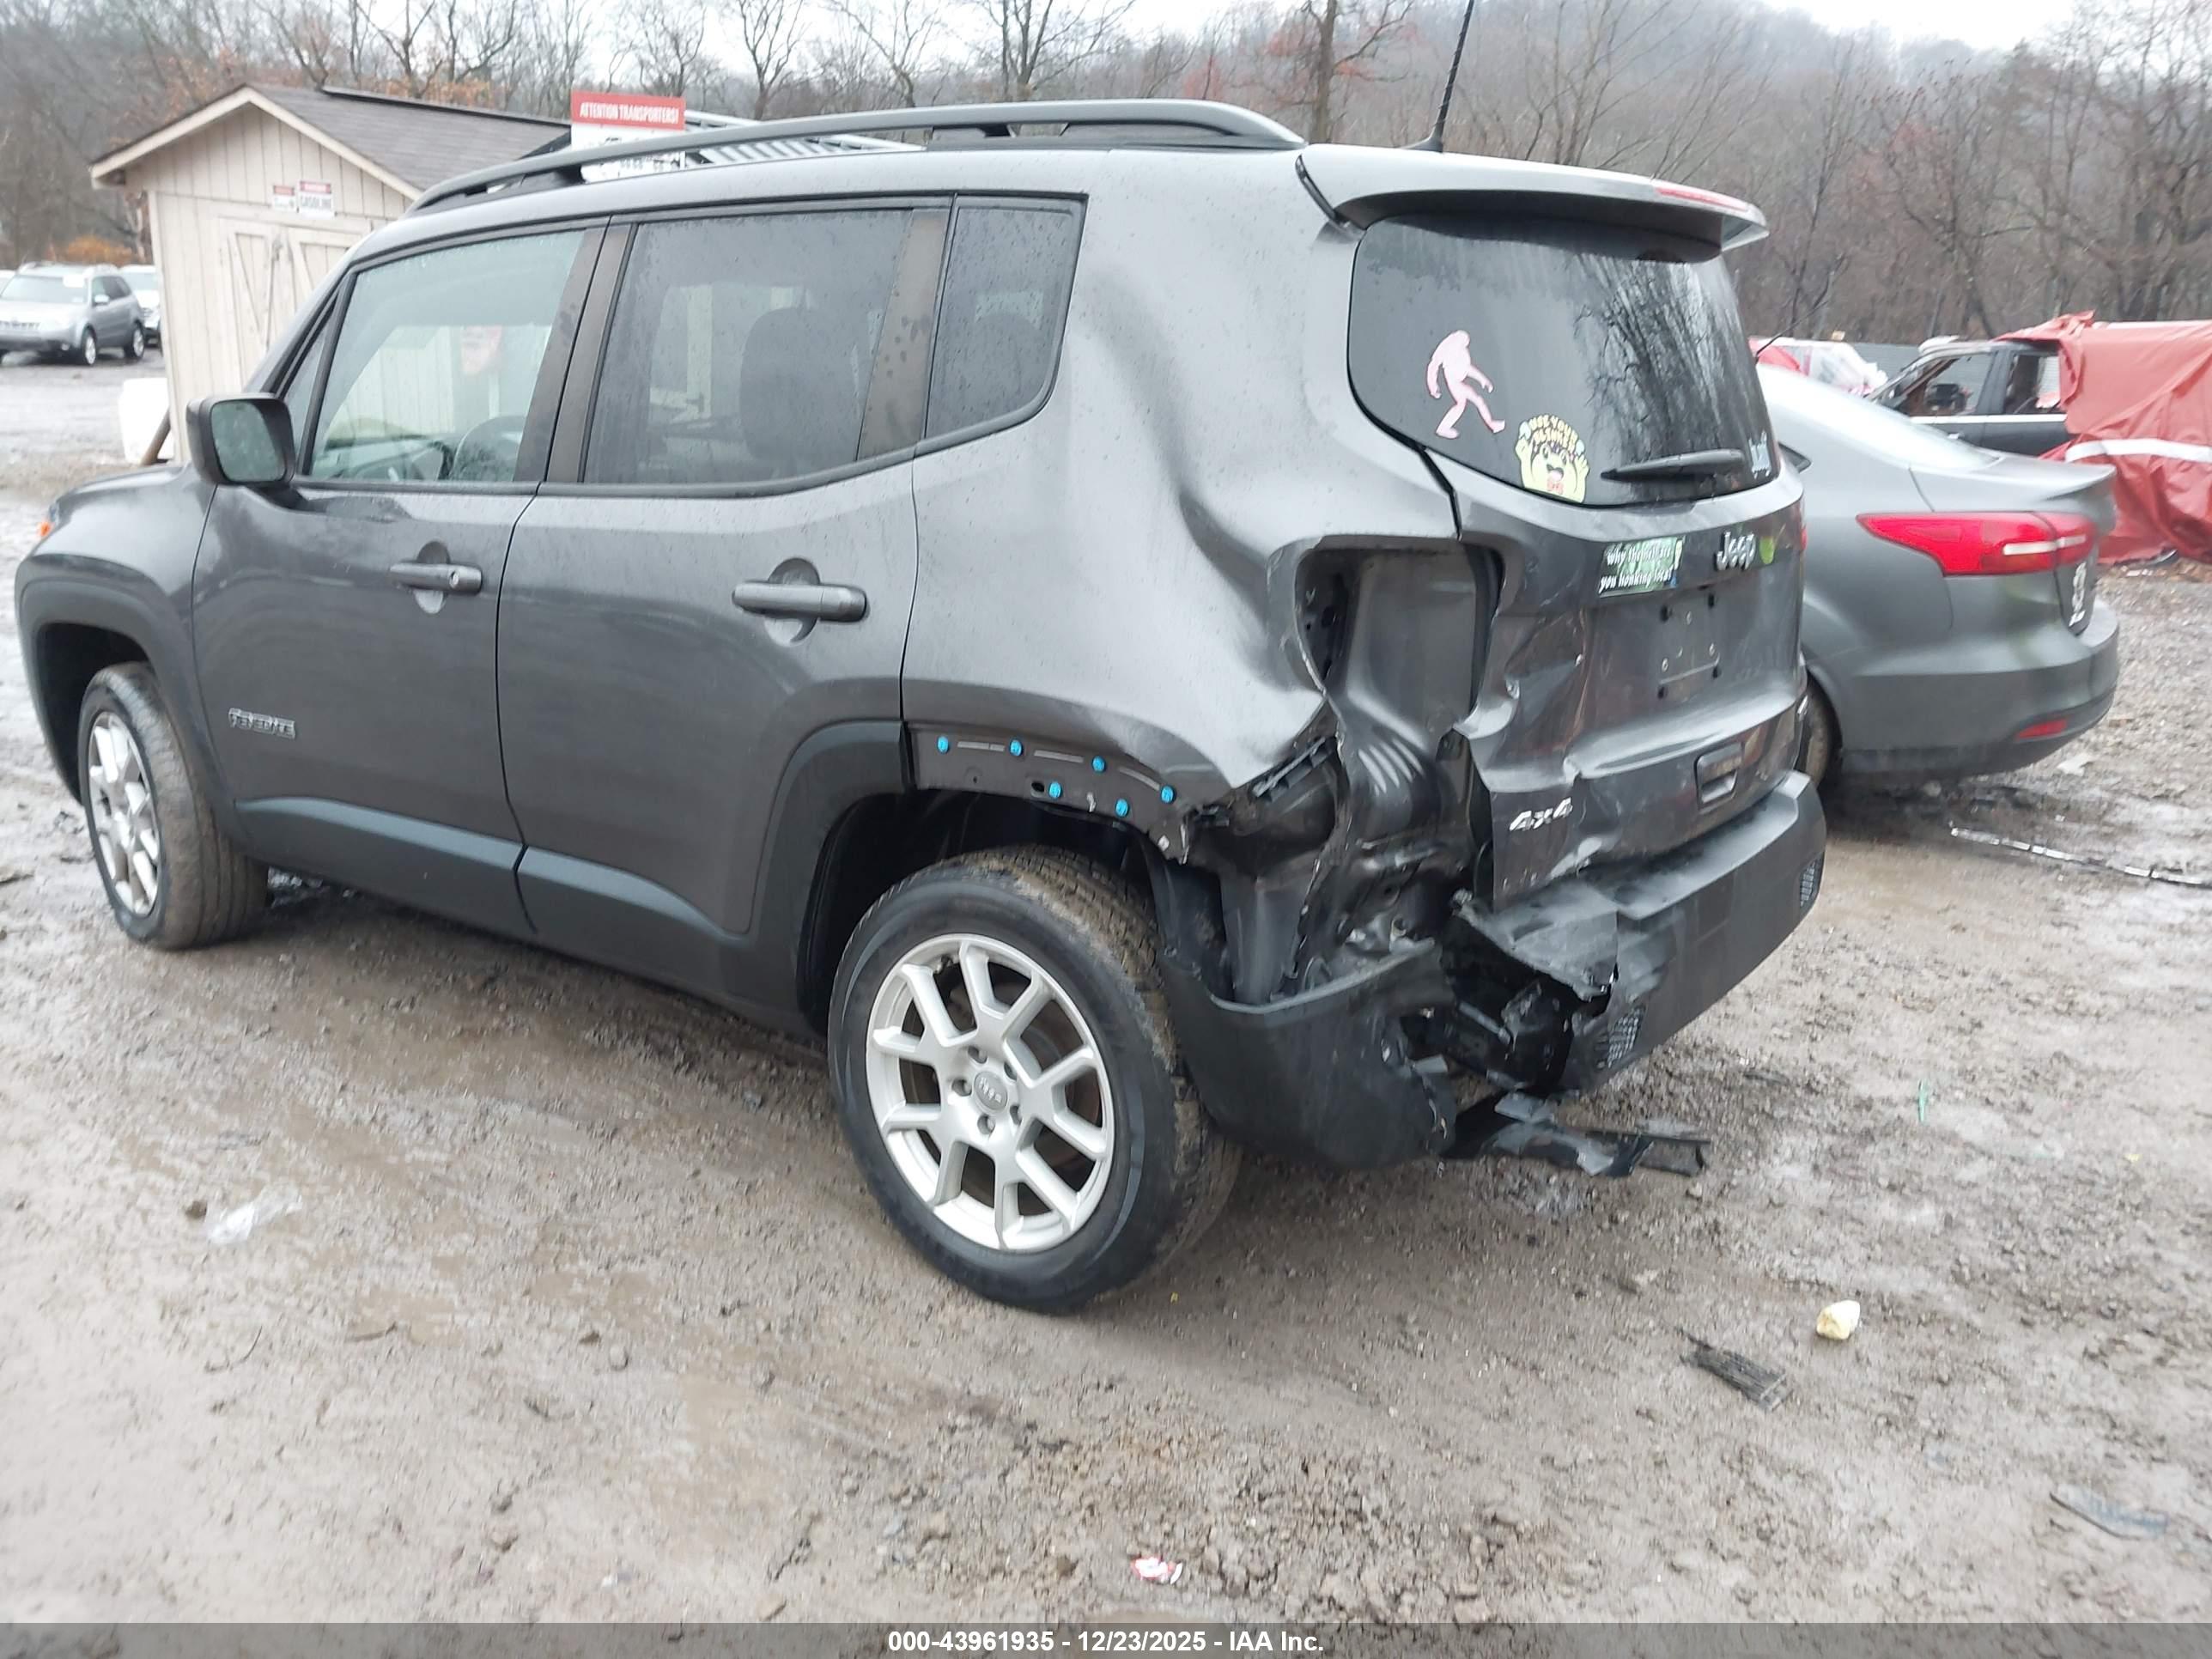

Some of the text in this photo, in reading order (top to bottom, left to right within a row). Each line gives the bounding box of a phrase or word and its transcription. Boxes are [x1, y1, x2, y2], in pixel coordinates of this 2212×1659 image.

[579, 101, 619, 120] ATTENTION
[1607, 547, 1626, 575] why
[1717, 531, 1756, 571] Jeep
[1599, 575, 1618, 594] you
[1618, 568, 1652, 589] honking
